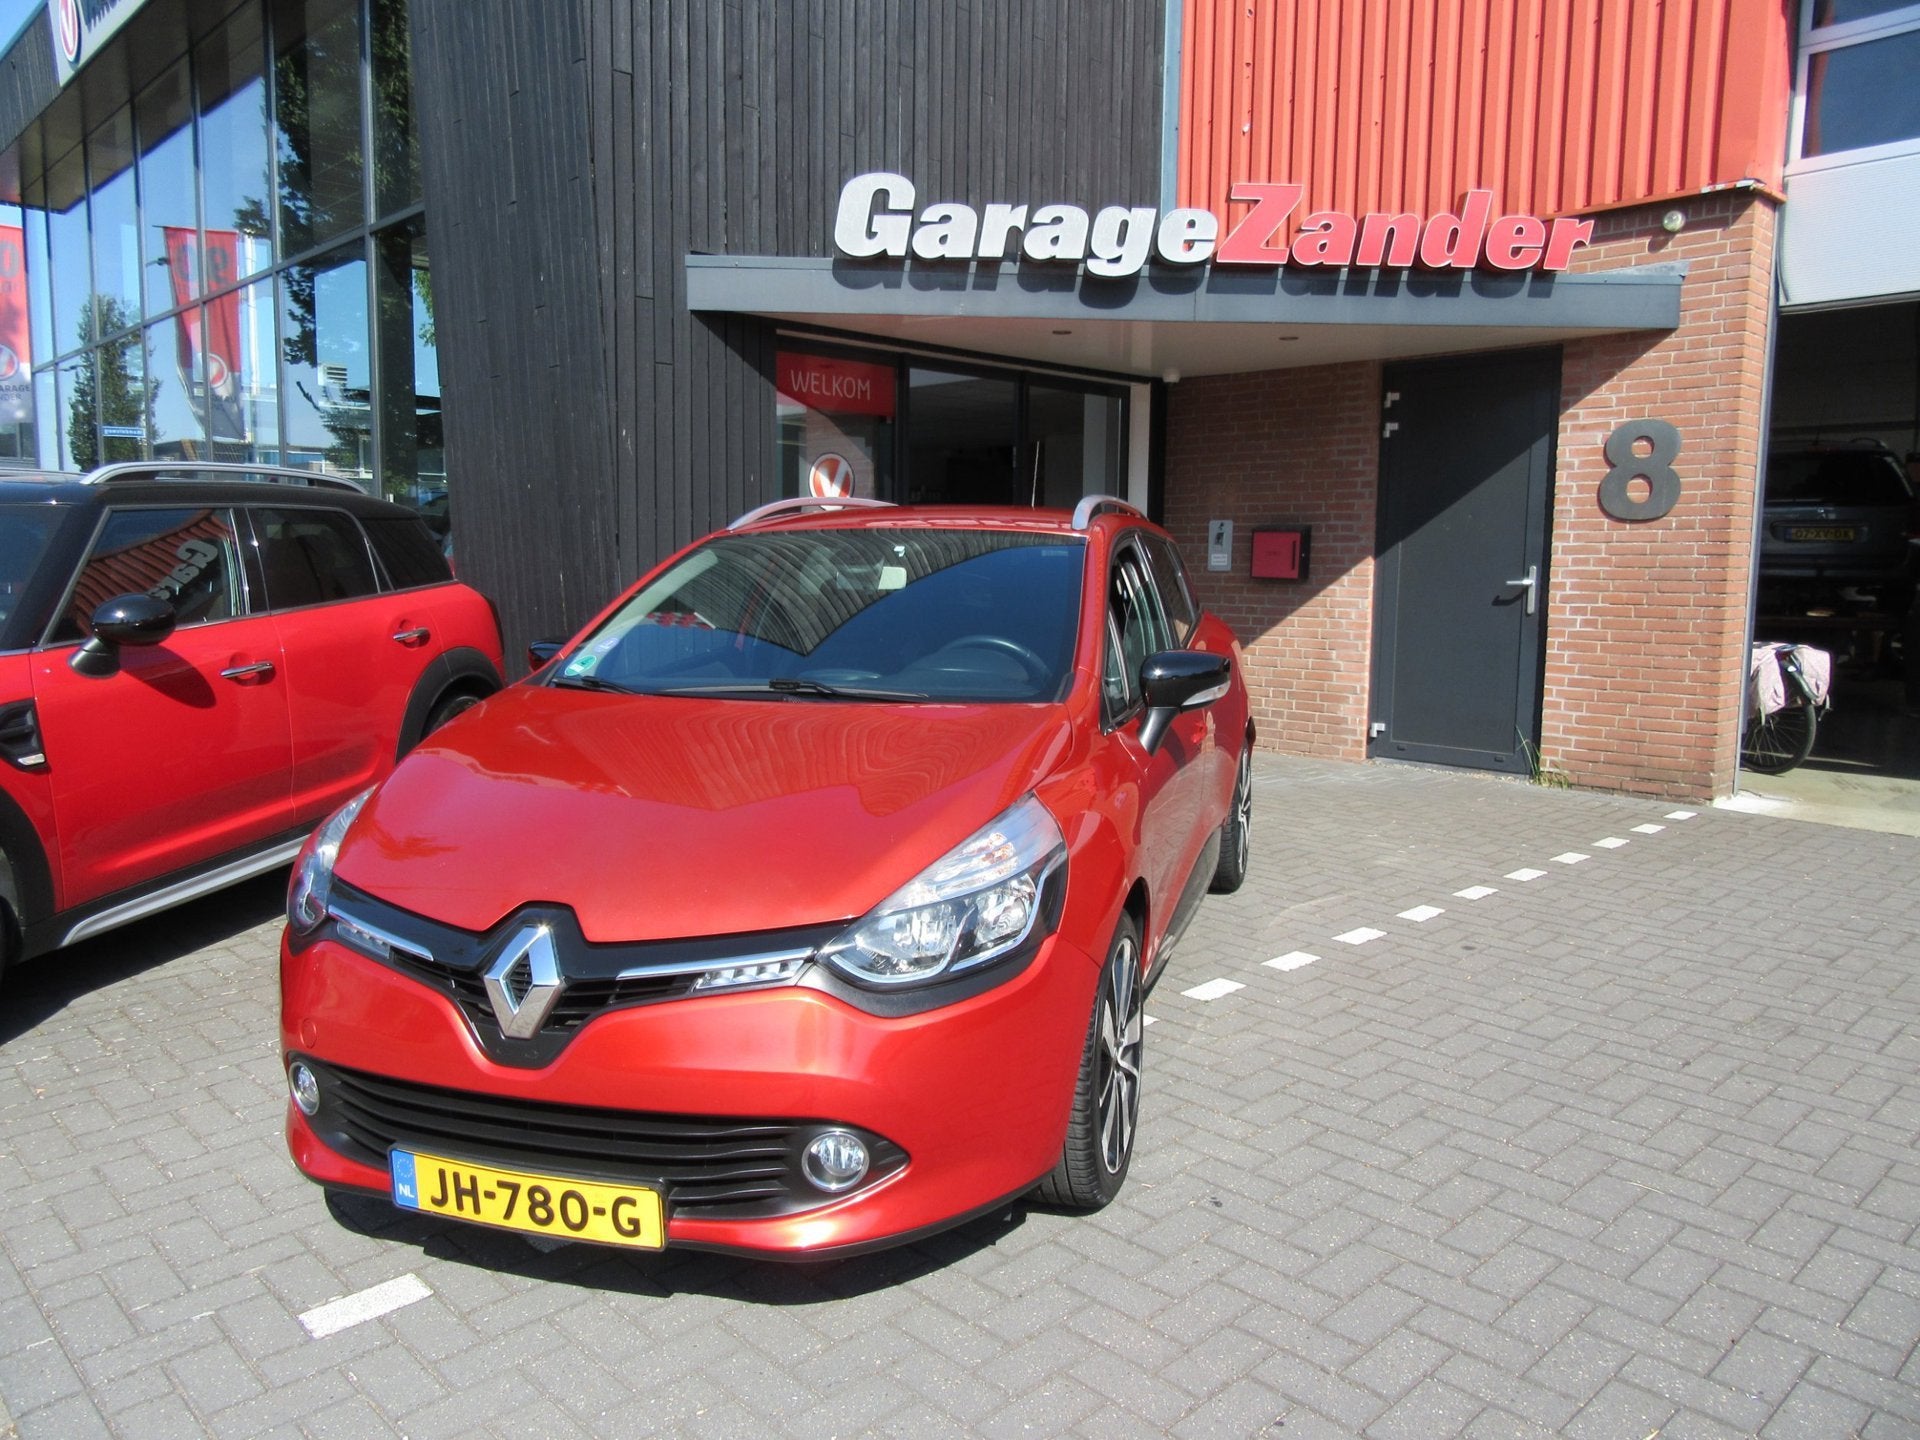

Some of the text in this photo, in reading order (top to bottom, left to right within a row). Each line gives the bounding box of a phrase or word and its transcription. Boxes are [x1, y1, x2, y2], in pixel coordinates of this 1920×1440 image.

[834, 172, 1594, 277] Garage Zander
[0, 384, 31, 392] ARAGE
[790, 369, 871, 401] WELKOM
[1600, 418, 1682, 520] 8
[399, 1182, 415, 1198] NL
[430, 1168, 641, 1238] JH-780-G
